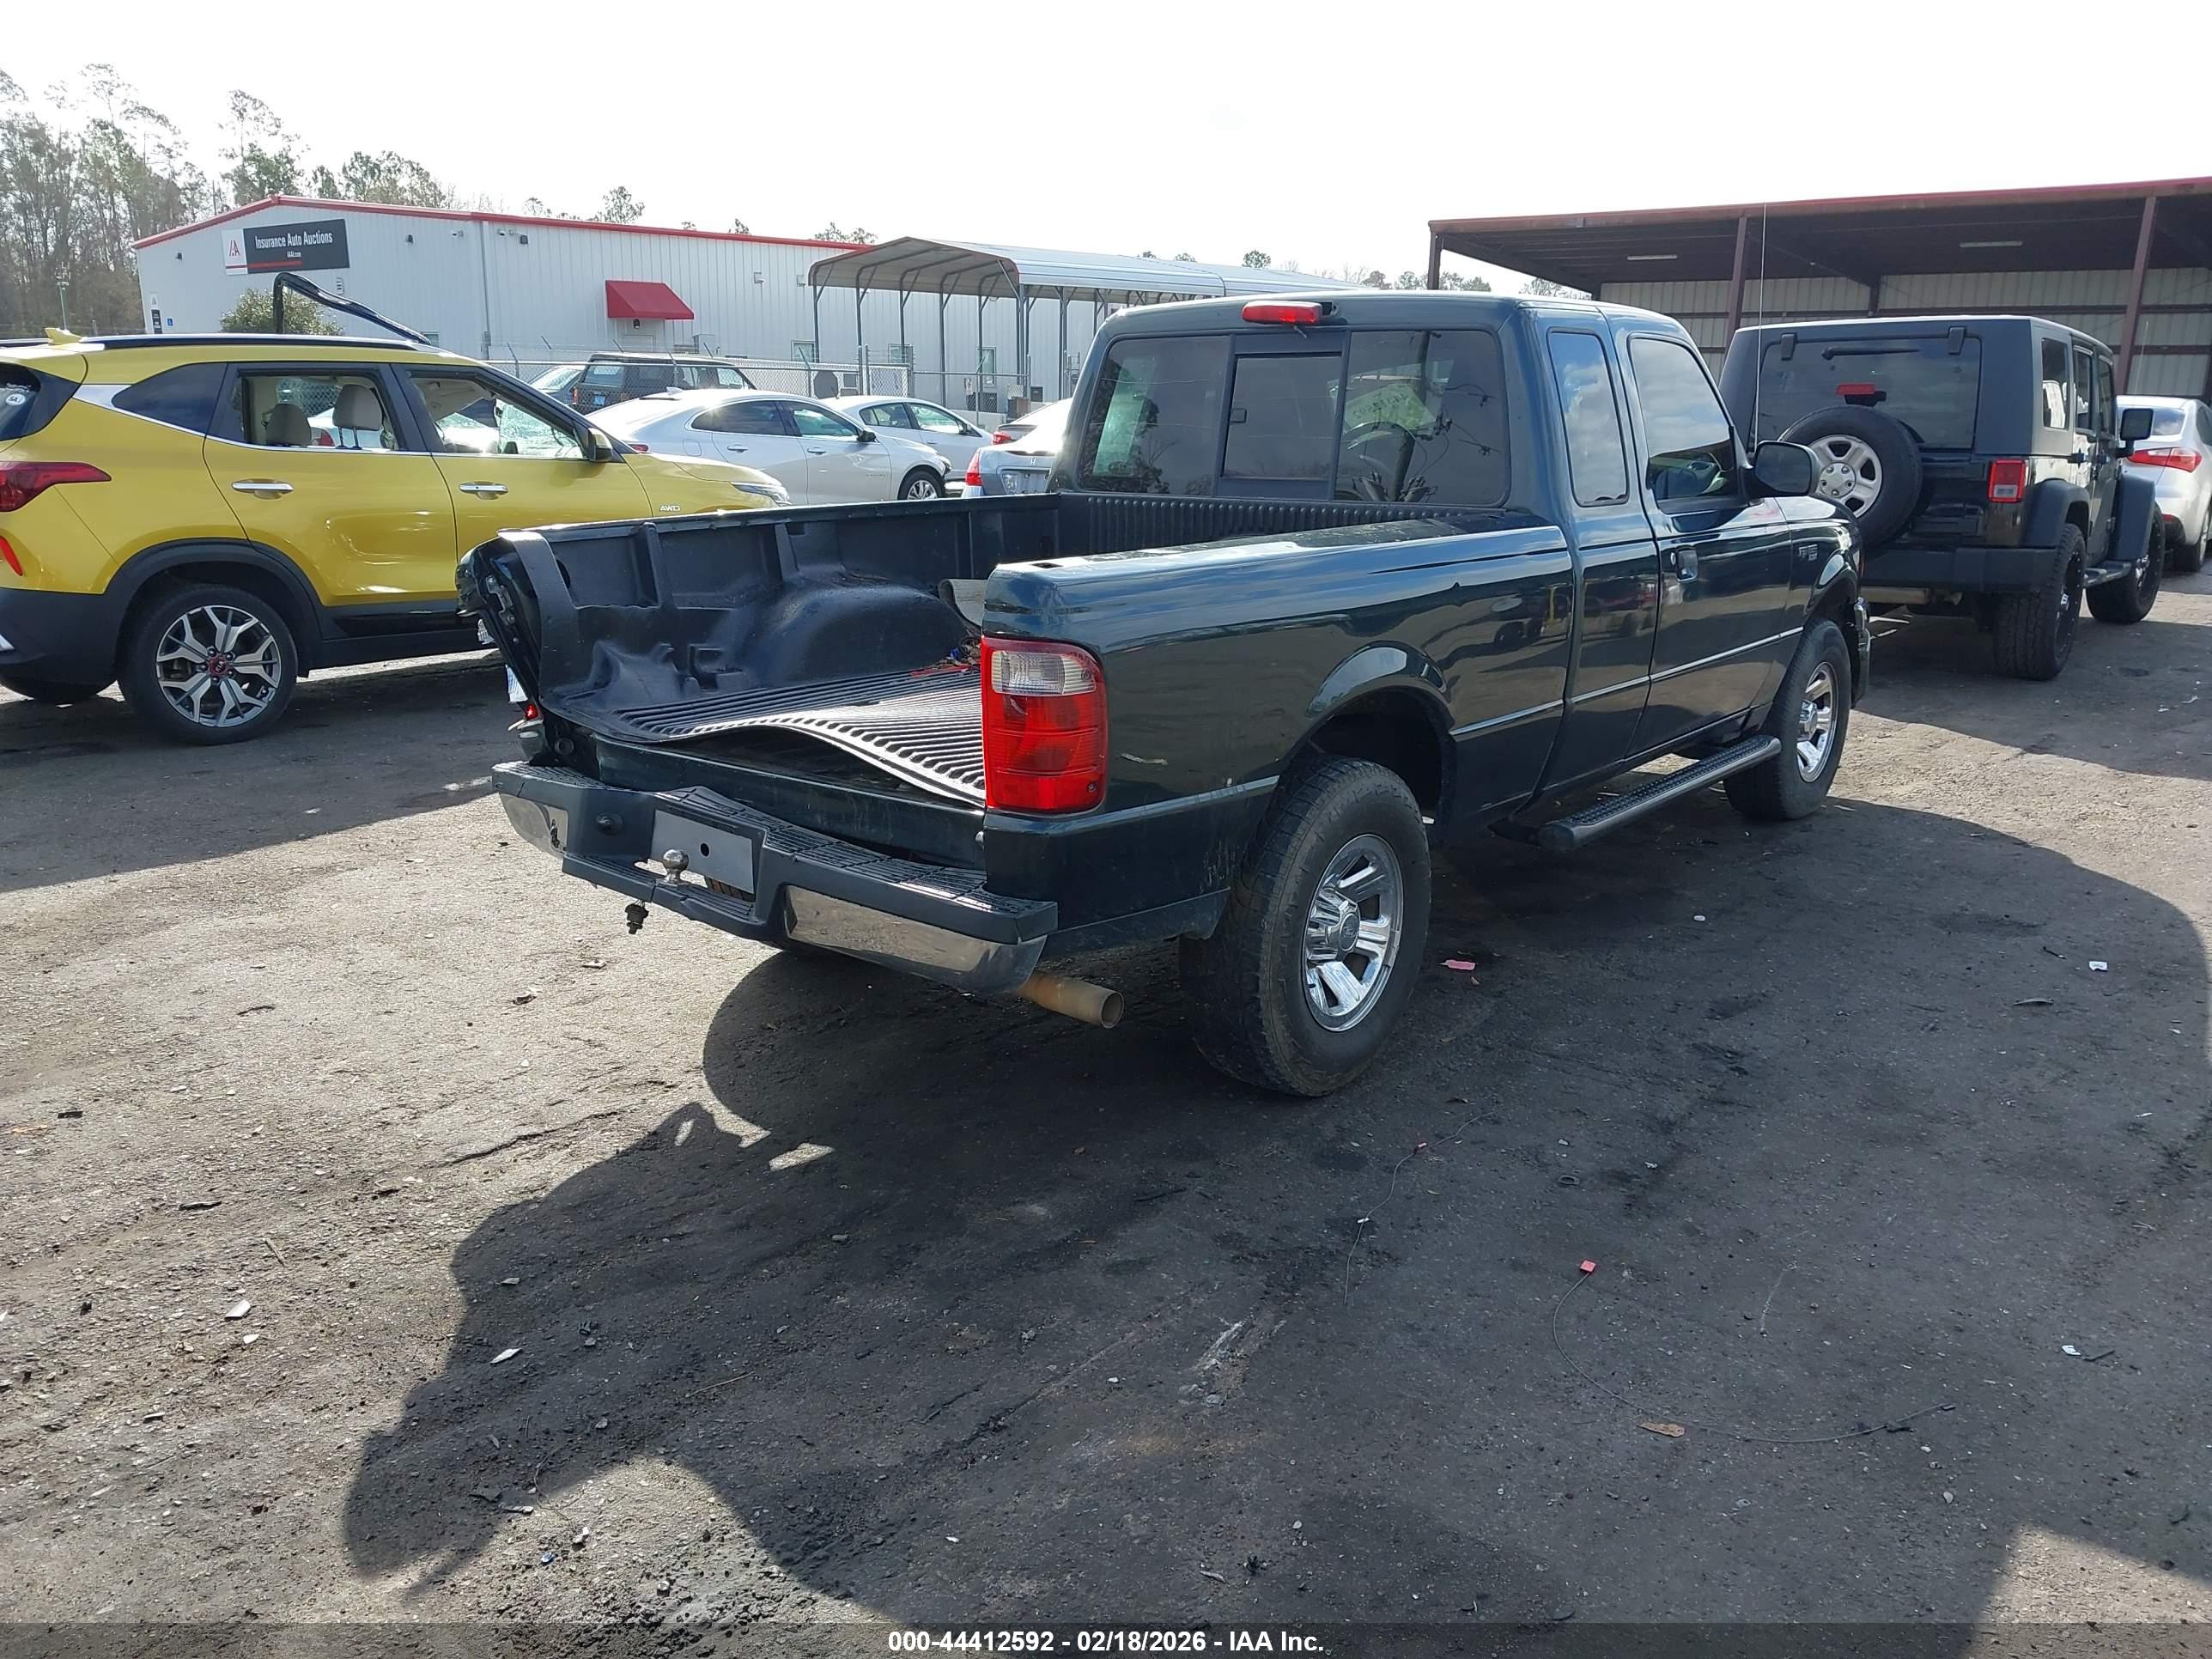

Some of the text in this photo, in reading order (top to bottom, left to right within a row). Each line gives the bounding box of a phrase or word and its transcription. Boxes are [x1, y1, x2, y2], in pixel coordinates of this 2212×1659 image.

[255, 230, 332, 249] Insurance Auto Auctions
